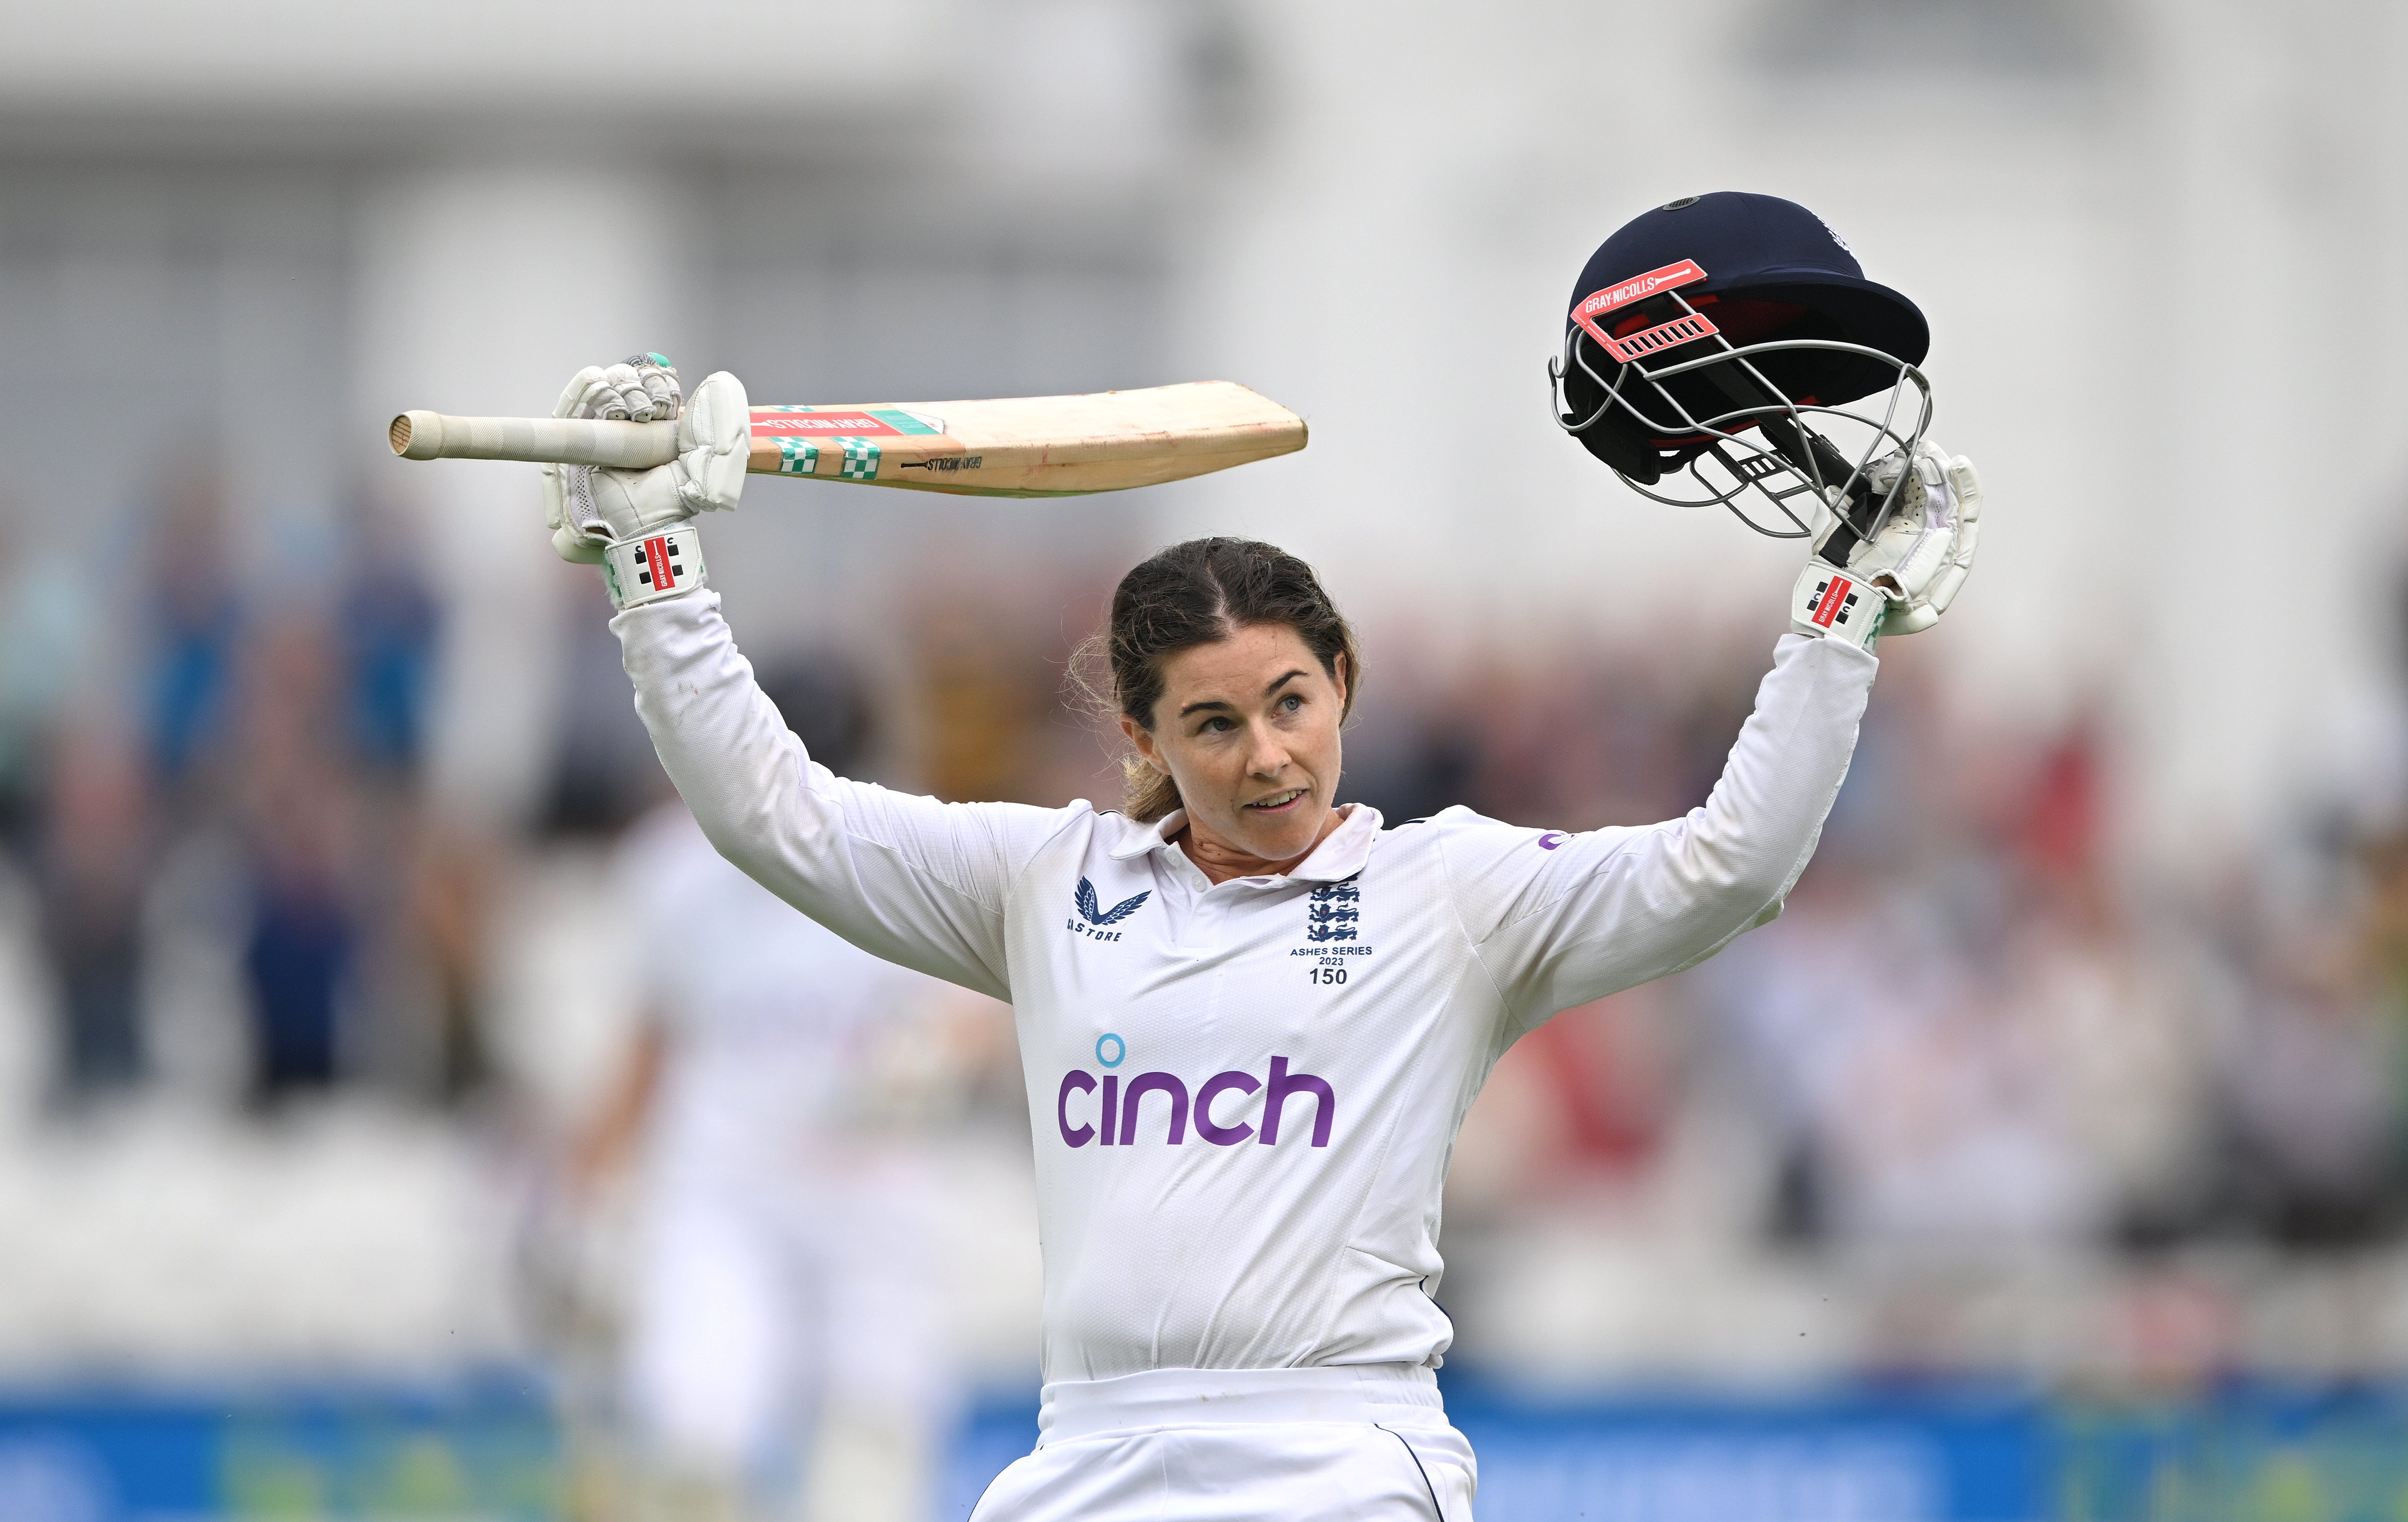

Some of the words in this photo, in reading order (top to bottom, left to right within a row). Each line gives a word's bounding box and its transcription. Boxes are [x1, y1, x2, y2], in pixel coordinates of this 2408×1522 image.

[1585, 276, 1656, 314] GRAY-NICOLLS
[768, 419, 880, 429] GRAY-NICOLLS
[654, 554, 668, 587] GRAY-NICOLLS
[1819, 592, 1838, 623] GRAY-NICOLLS
[1067, 918, 1122, 942] CASTORE
[1290, 947, 1328, 956] ASHES
[1332, 946, 1372, 955] SERIES
[1319, 957, 1343, 966] 2023
[1309, 968, 1347, 984] 150
[1058, 1033, 1335, 1148] cinch
